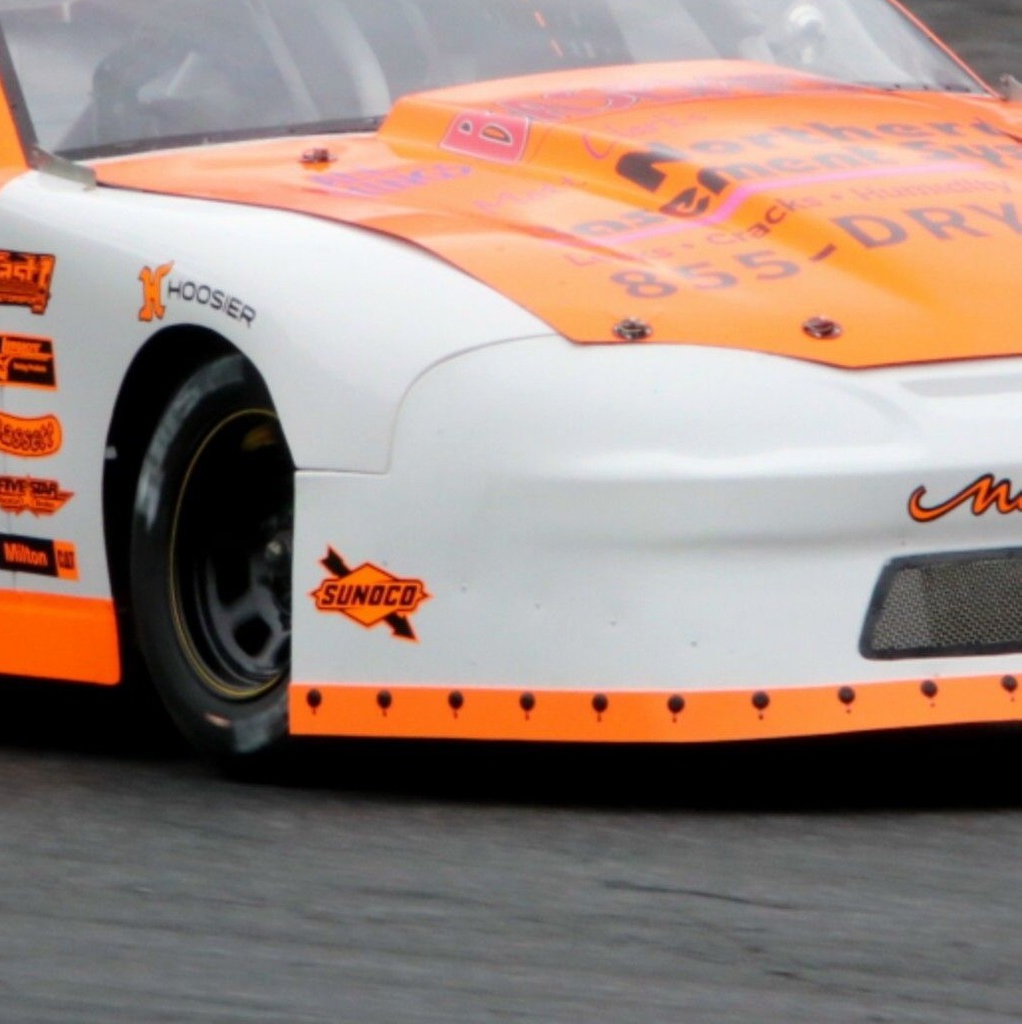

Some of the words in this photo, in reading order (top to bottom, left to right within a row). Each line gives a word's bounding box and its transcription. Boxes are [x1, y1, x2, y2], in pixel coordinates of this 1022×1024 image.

[167, 279, 257, 329] HOOSIER
[3, 540, 48, 566] Milton
[320, 583, 419, 607] SUNOCO
